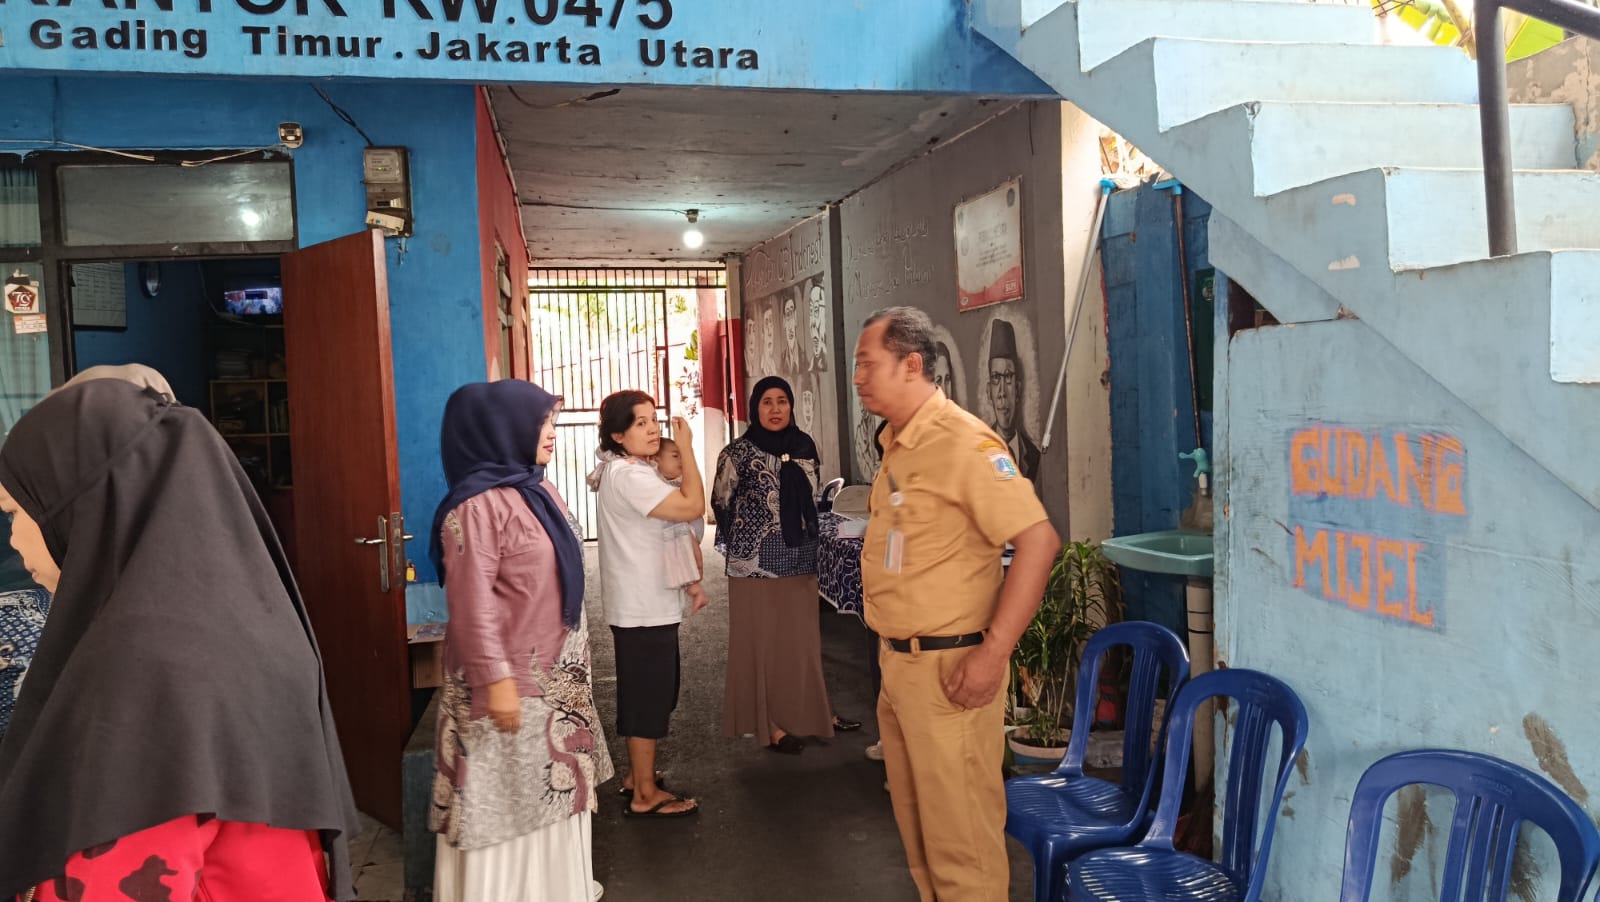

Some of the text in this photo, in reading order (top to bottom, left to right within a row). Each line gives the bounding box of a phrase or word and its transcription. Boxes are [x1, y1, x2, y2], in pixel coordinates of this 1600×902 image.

[30, 19, 207, 58] Gading
[417, 32, 601, 65] Jakarta
[640, 38, 759, 70] Utara
[1289, 424, 1467, 516] GUDANG
